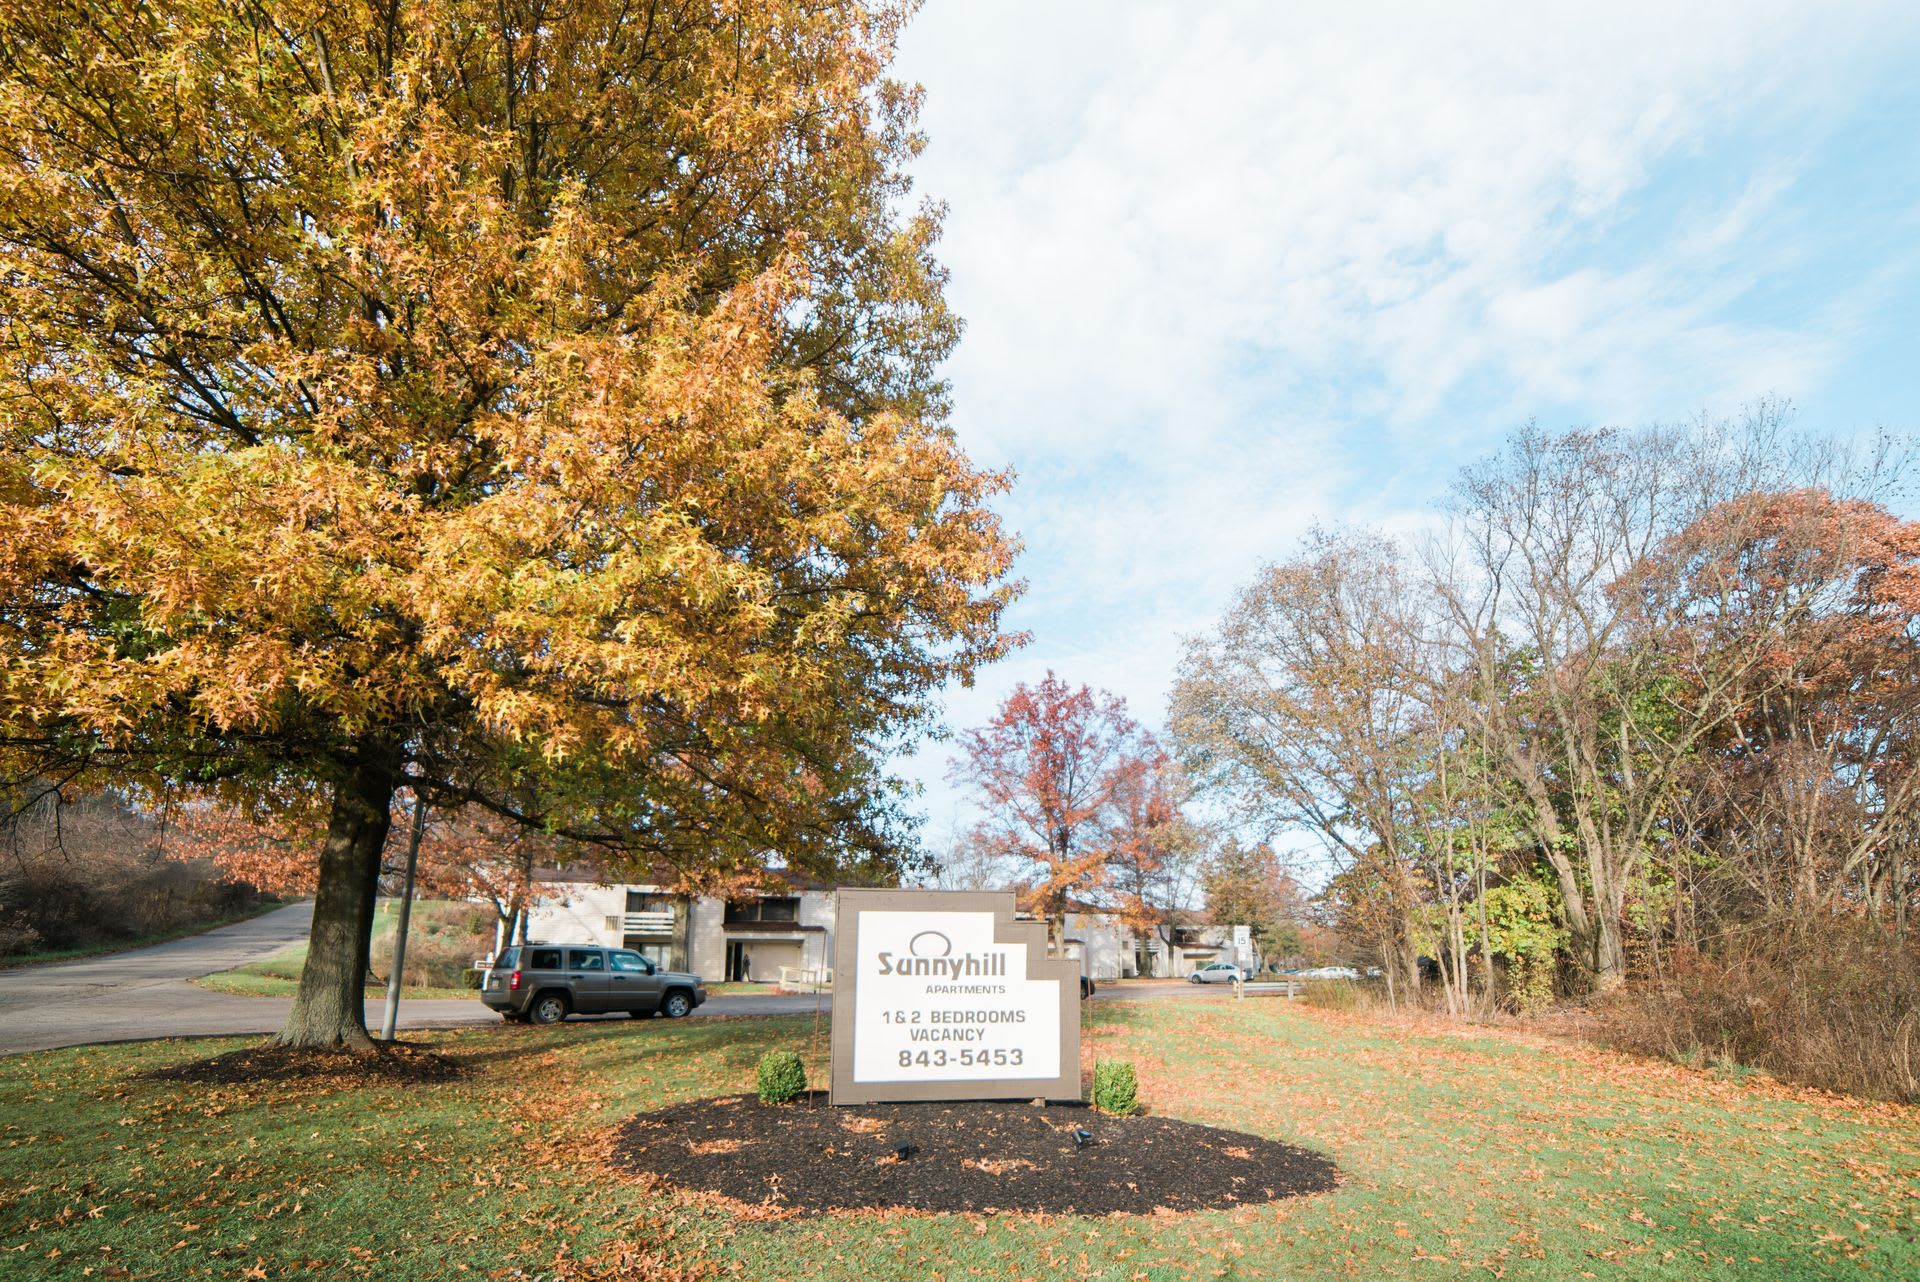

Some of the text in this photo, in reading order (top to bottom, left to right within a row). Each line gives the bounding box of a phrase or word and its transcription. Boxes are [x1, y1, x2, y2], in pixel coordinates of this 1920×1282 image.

[1238, 937, 1247, 945] 15
[878, 952, 1006, 981] Sunnyhill
[925, 985, 1006, 994] APARTMENTS
[930, 1010, 1026, 1024] BEDROOMS
[909, 1028, 985, 1042] VACANCY
[898, 1048, 1024, 1068] 843-5453
